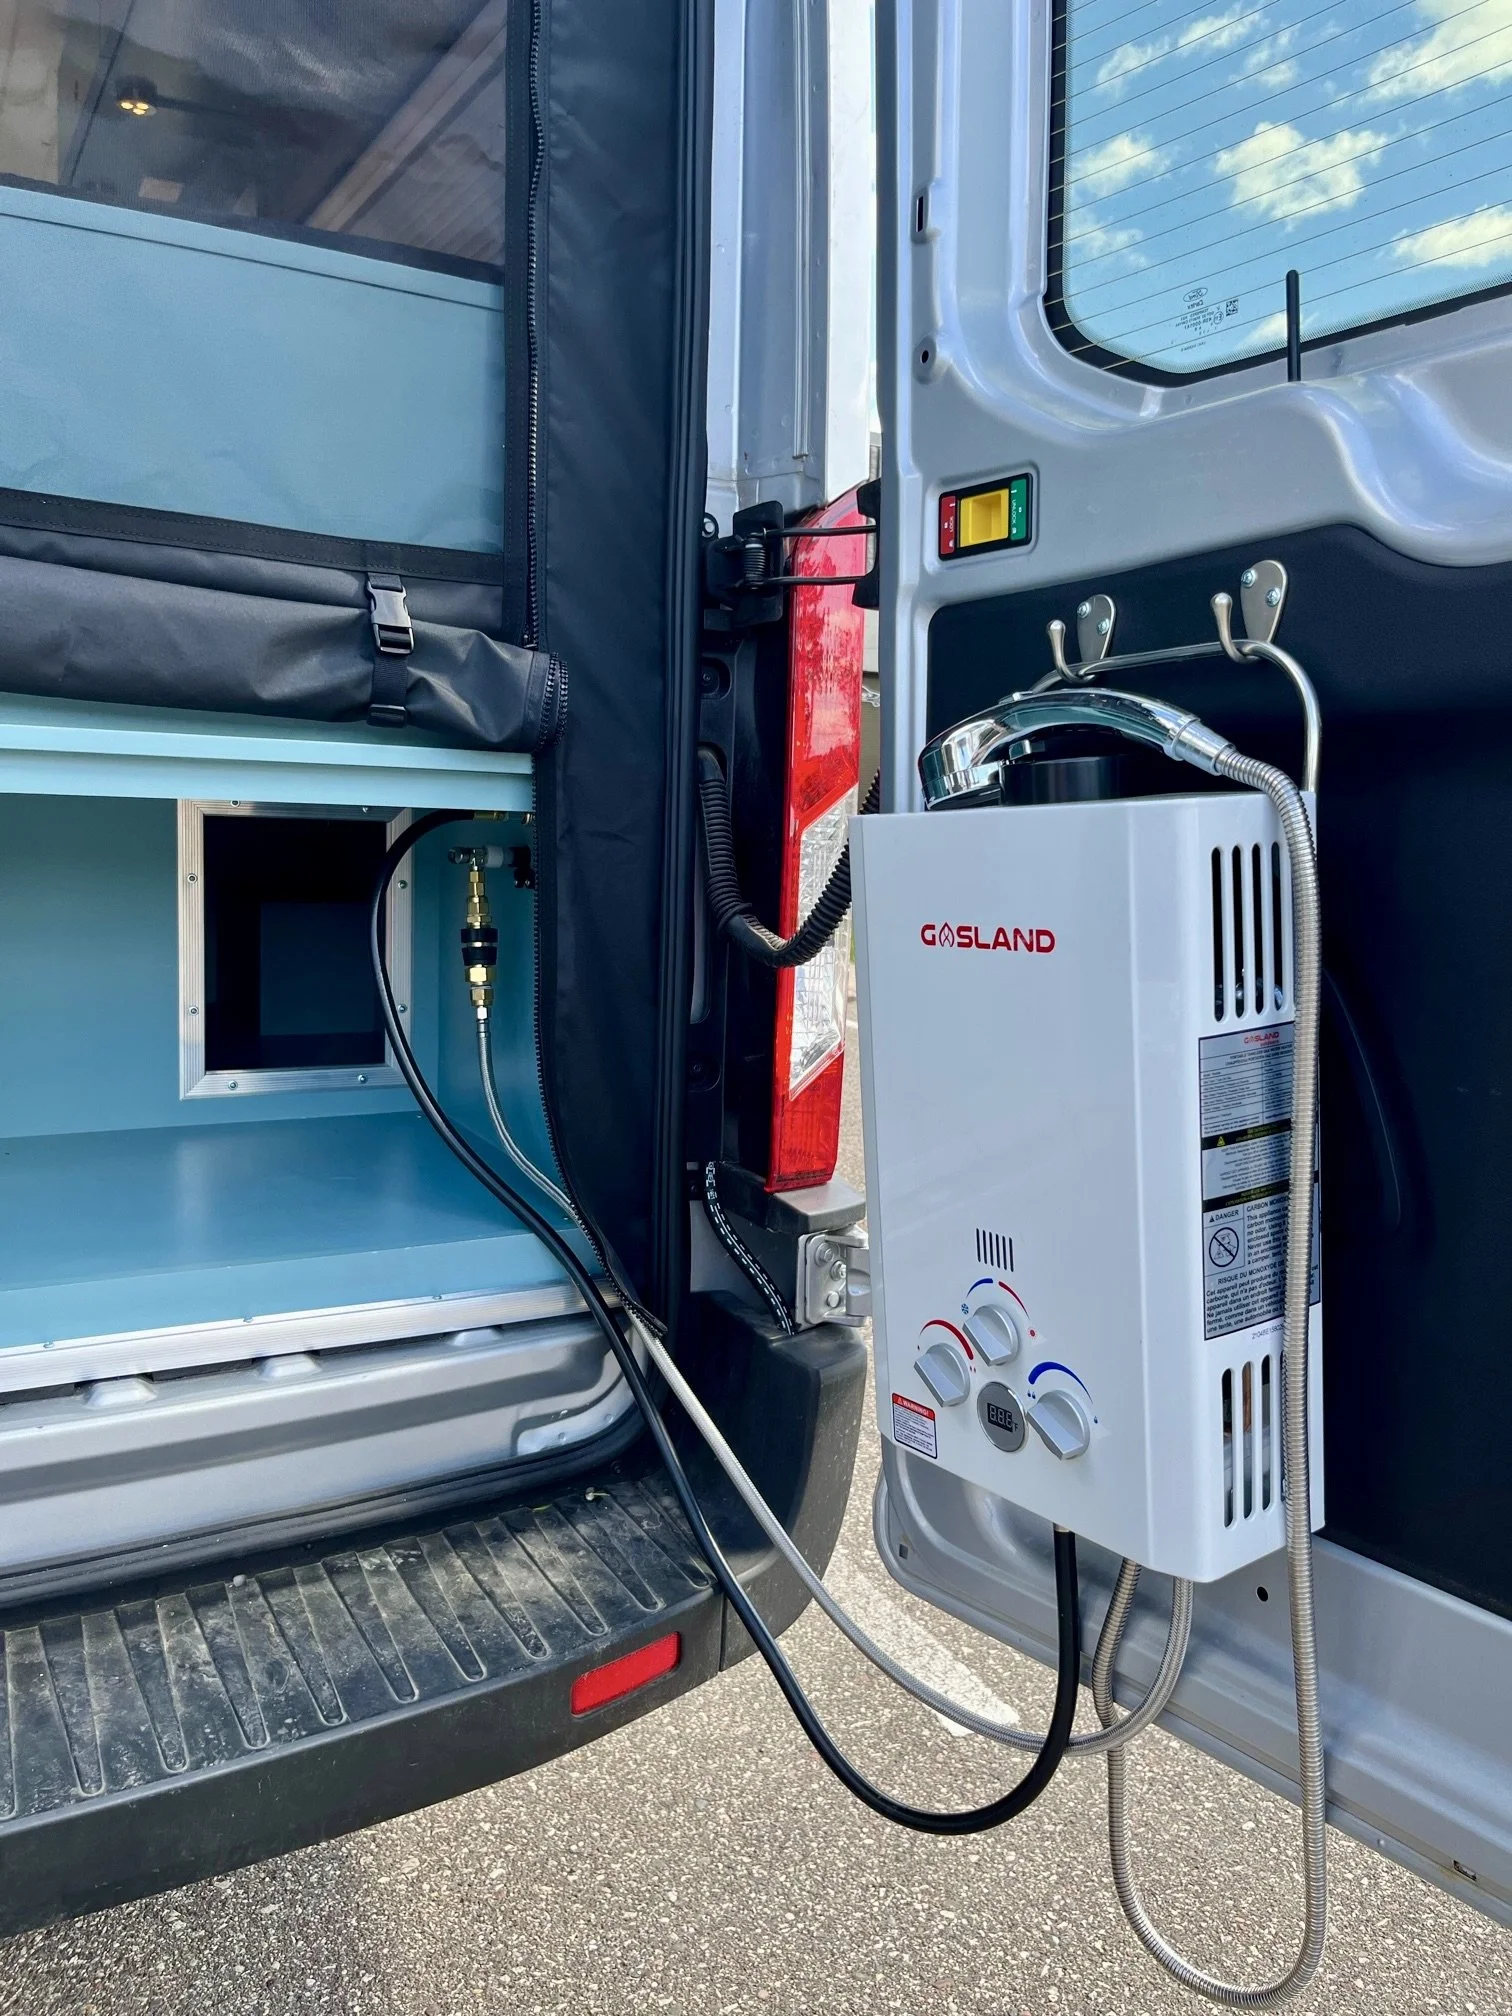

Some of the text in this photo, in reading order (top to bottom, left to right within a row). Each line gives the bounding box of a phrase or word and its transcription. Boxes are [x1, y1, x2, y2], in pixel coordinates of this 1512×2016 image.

[921, 921, 1056, 954] GASLAND
[1246, 1202, 1268, 1212] CARBON
[1215, 1210, 1239, 1221] DANGER
[1247, 1220, 1264, 1228] carbon
[1248, 1241, 1262, 1250] Never
[1218, 1274, 1238, 1284] RISQUE
[1249, 1263, 1277, 1276] MONOXYDE
[1206, 1289, 1216, 1297] Cet
[1217, 1283, 1237, 1295] appareil
[1250, 1274, 1271, 1287] produire
[1206, 1301, 1228, 1311] appareil
[1229, 1297, 1242, 1305] dans
